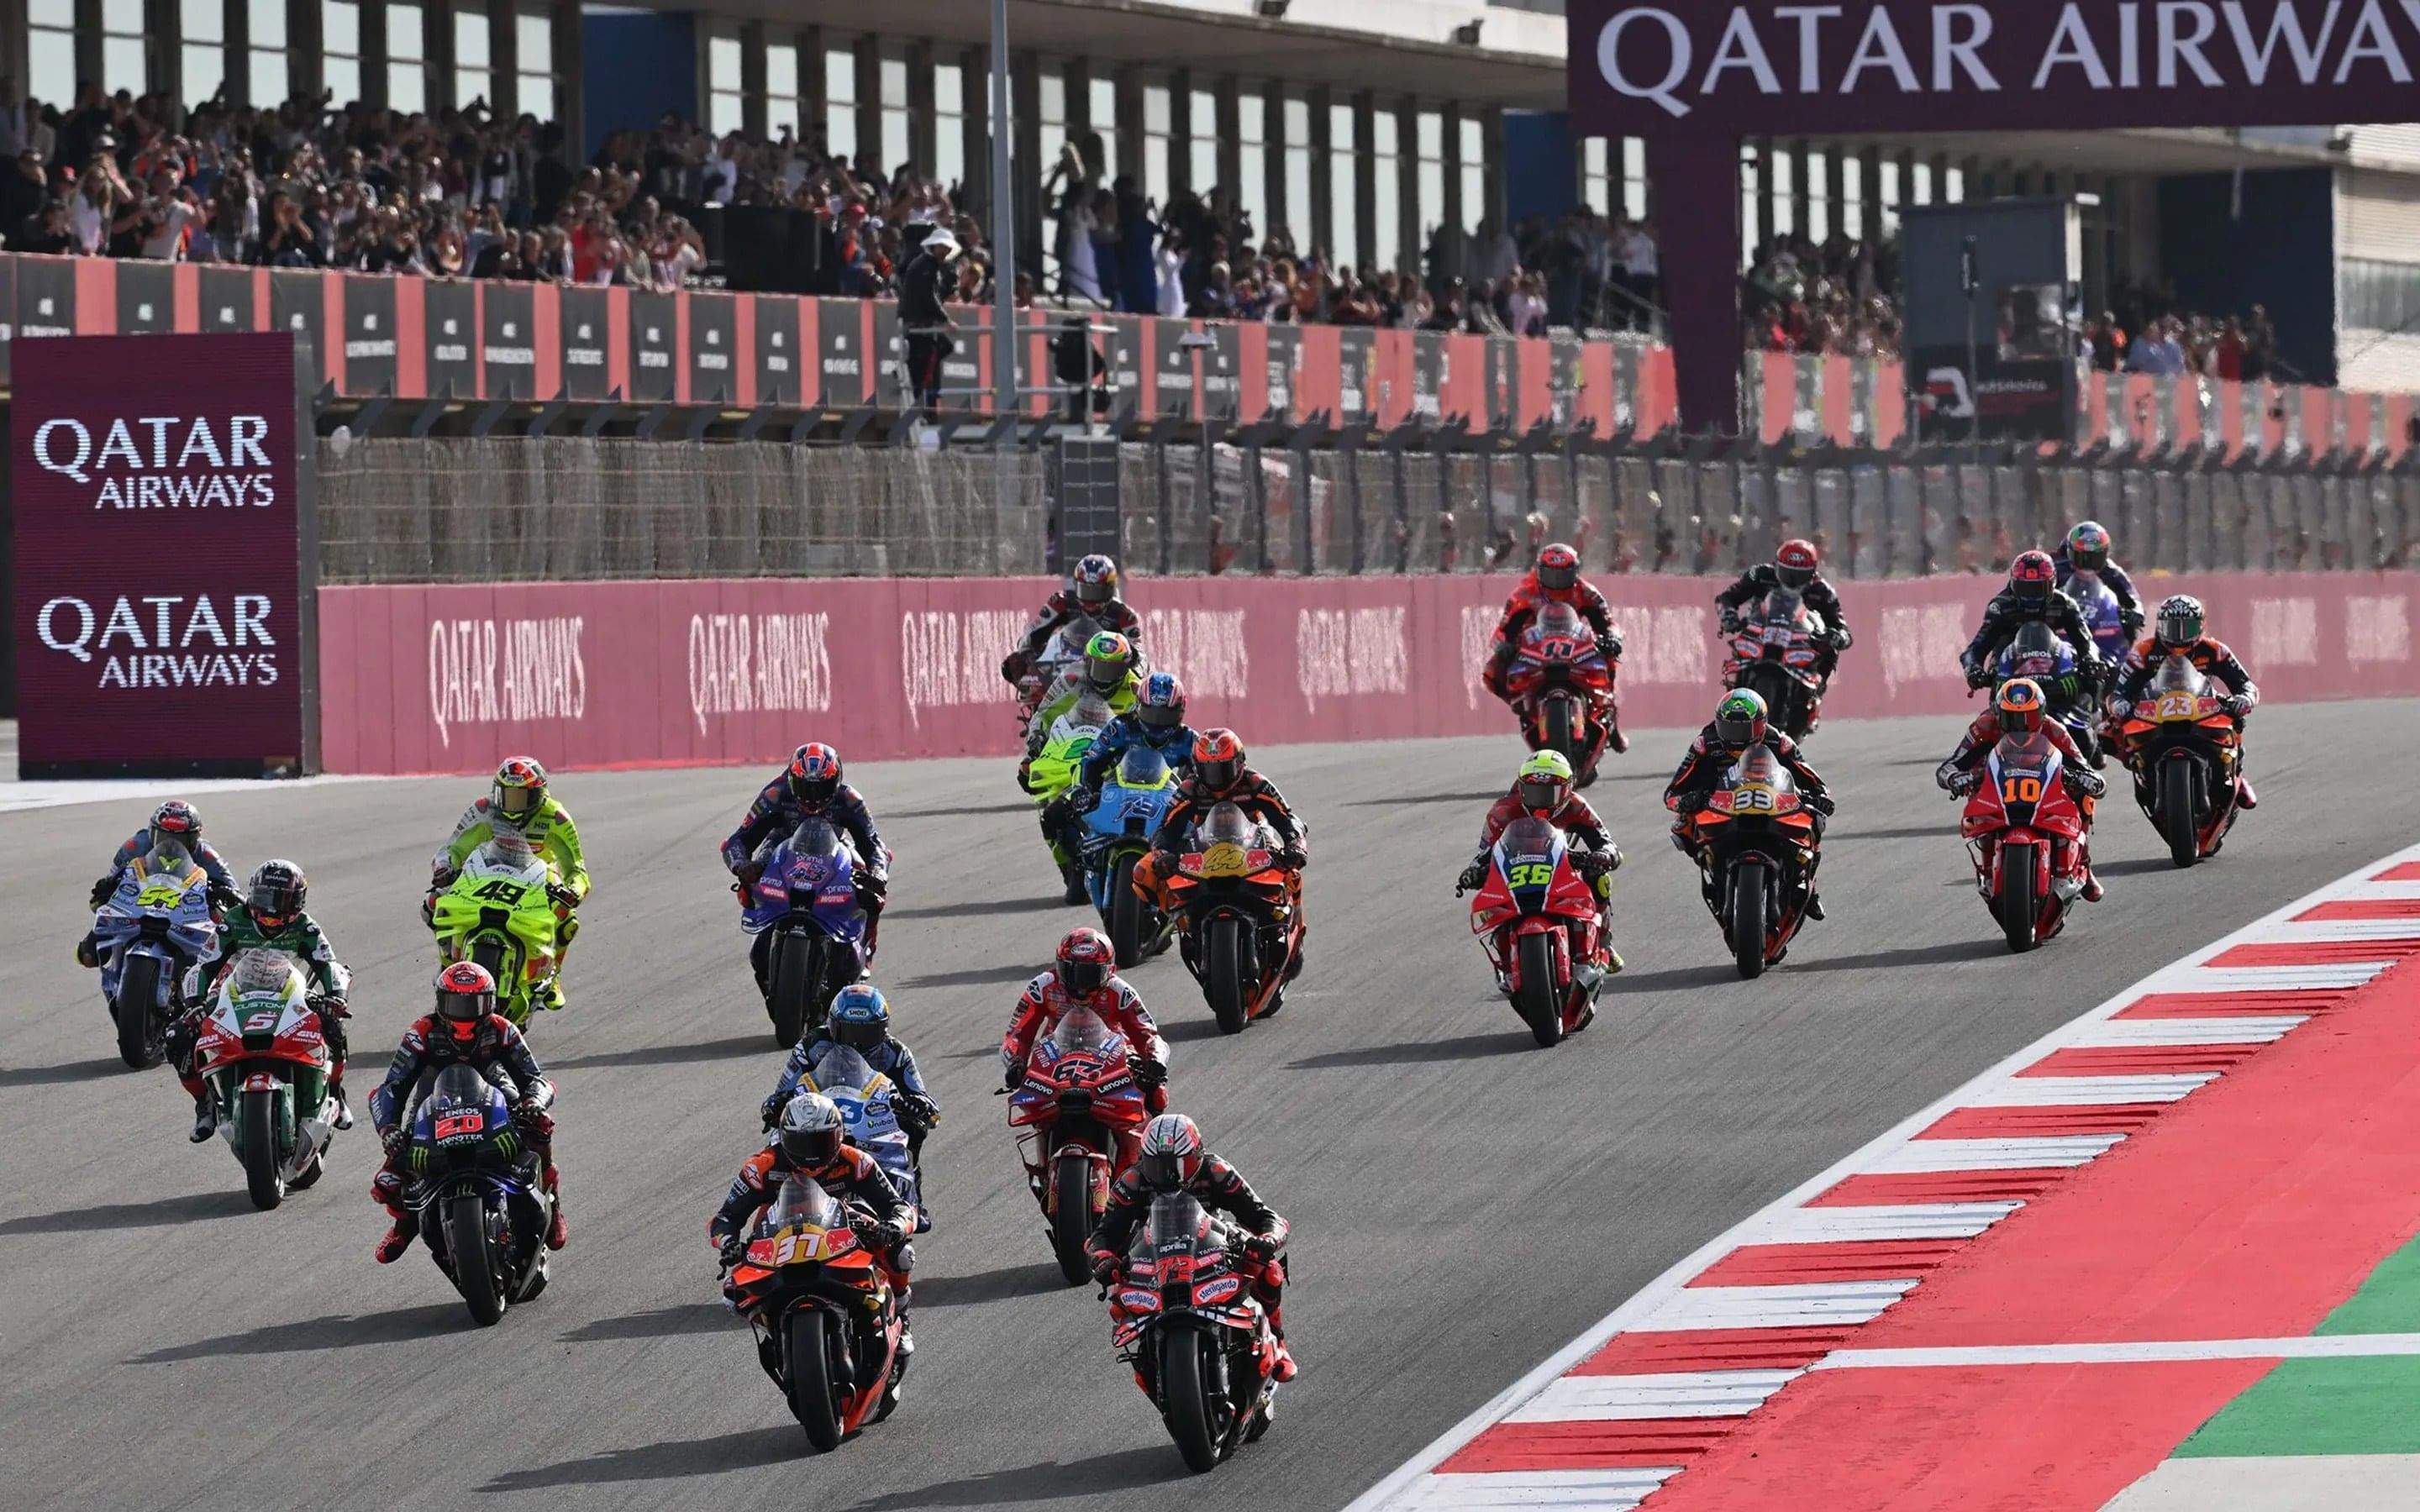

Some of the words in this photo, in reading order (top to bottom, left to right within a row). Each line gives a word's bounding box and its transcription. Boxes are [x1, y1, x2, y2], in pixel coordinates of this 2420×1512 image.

[1597, 4, 2002, 118] QATAR
[2031, 0, 2420, 89] AIRWA
[33, 416, 272, 483] QATAR
[95, 473, 276, 509] AIRWAYS
[37, 593, 276, 662] QATAR
[2023, 650, 2052, 659] ENEOS
[98, 653, 279, 689] AIRWAYS
[429, 620, 499, 748] QATAR
[503, 616, 585, 721] AIRWAYS
[688, 614, 751, 738] QATAR
[755, 612, 831, 711] AIRWAYS
[902, 611, 959, 731] QATAR
[2161, 696, 2192, 717] 23
[1733, 789, 1773, 811] 33
[2003, 777, 2041, 805] 10
[1508, 864, 1553, 890] 36
[136, 884, 182, 910] 54
[472, 880, 527, 906] 49
[825, 885, 853, 895] prima
[235, 1001, 286, 1011] CUSTOM
[211, 1022, 235, 1042] SENA
[243, 1011, 278, 1032] 5
[281, 1019, 308, 1039] SENA
[197, 1033, 219, 1047] GIVI
[296, 1030, 322, 1040] GIVI
[1051, 1058, 1105, 1083] 63
[1023, 1078, 1054, 1095] Lenovo
[1097, 1075, 1131, 1095] Lenovo
[445, 1107, 480, 1118] ENEOS
[434, 1112, 484, 1140] 20
[436, 1133, 485, 1147] MONSTER
[775, 1233, 821, 1266] 37
[1159, 1242, 1187, 1253] aprilia
[1122, 1290, 1157, 1308] sterilgarda
[1198, 1277, 1239, 1300] sterilgarda
